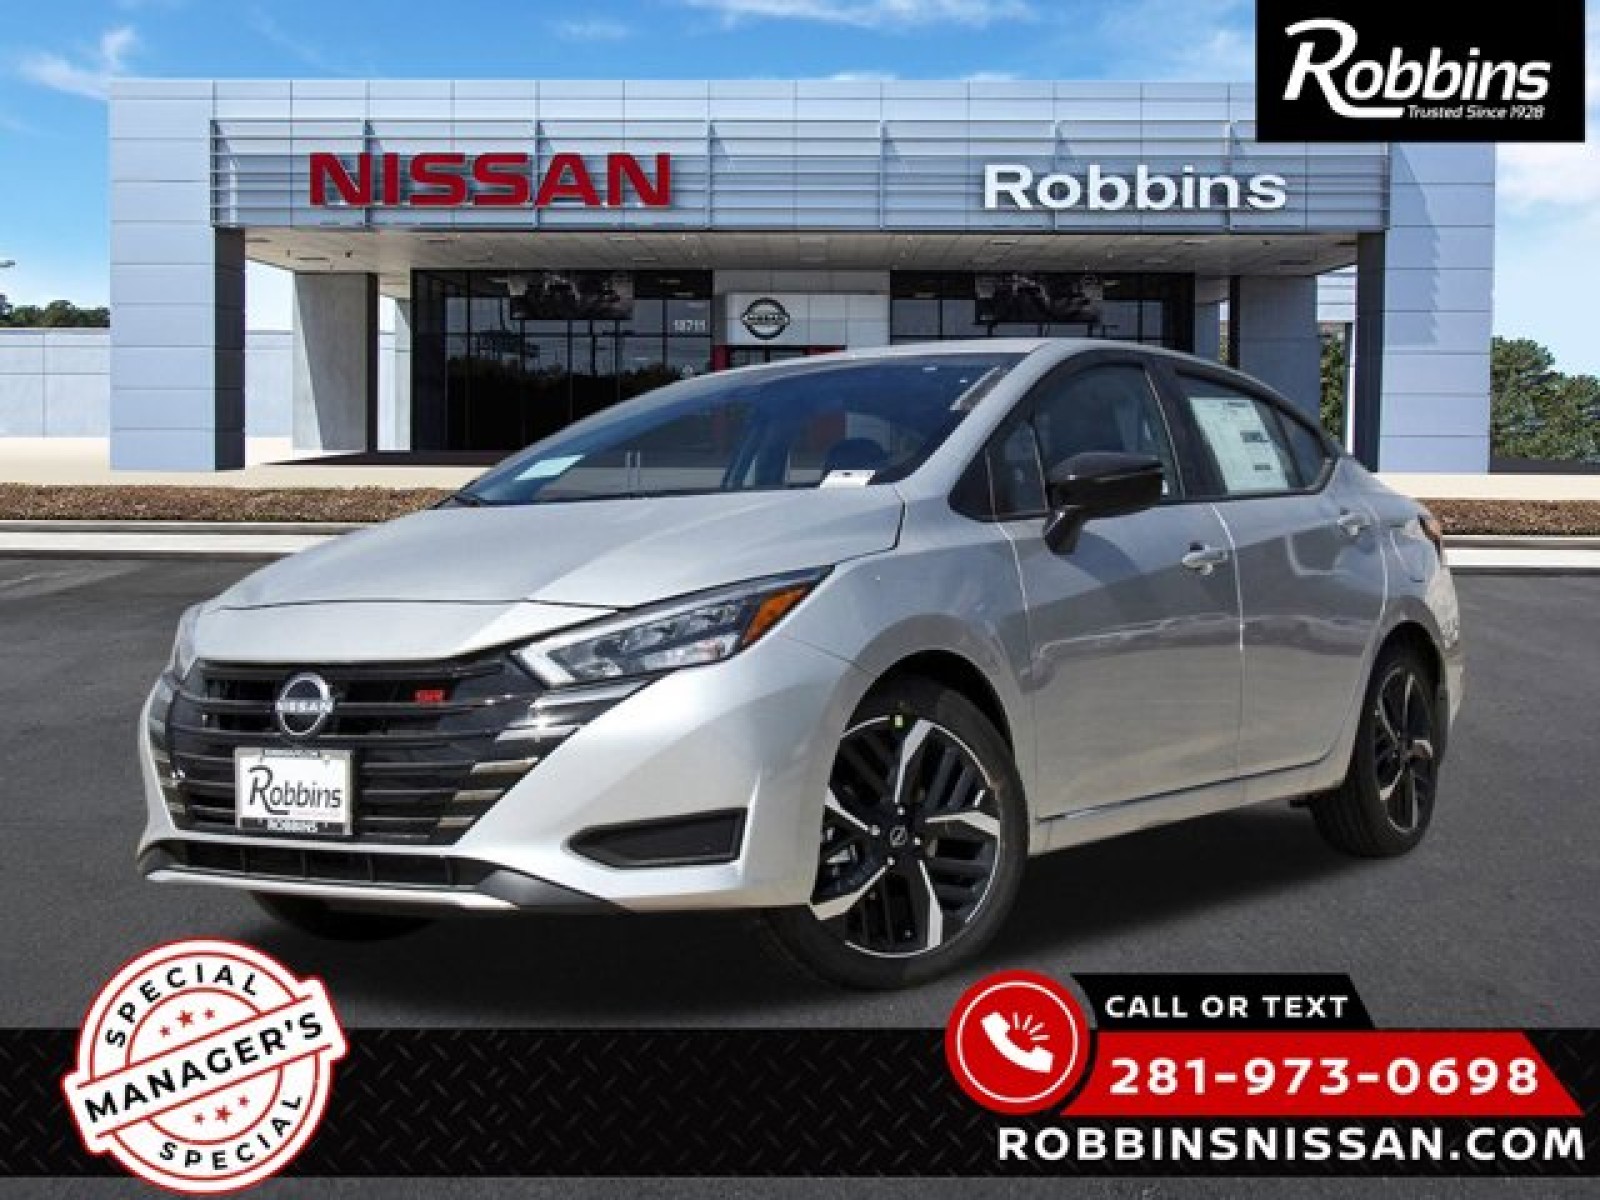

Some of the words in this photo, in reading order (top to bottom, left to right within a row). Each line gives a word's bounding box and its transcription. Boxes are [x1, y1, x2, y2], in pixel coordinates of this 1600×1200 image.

[309, 153, 671, 208] NISSAN
[983, 164, 1288, 211] Robbins
[247, 764, 342, 816] Robbins
